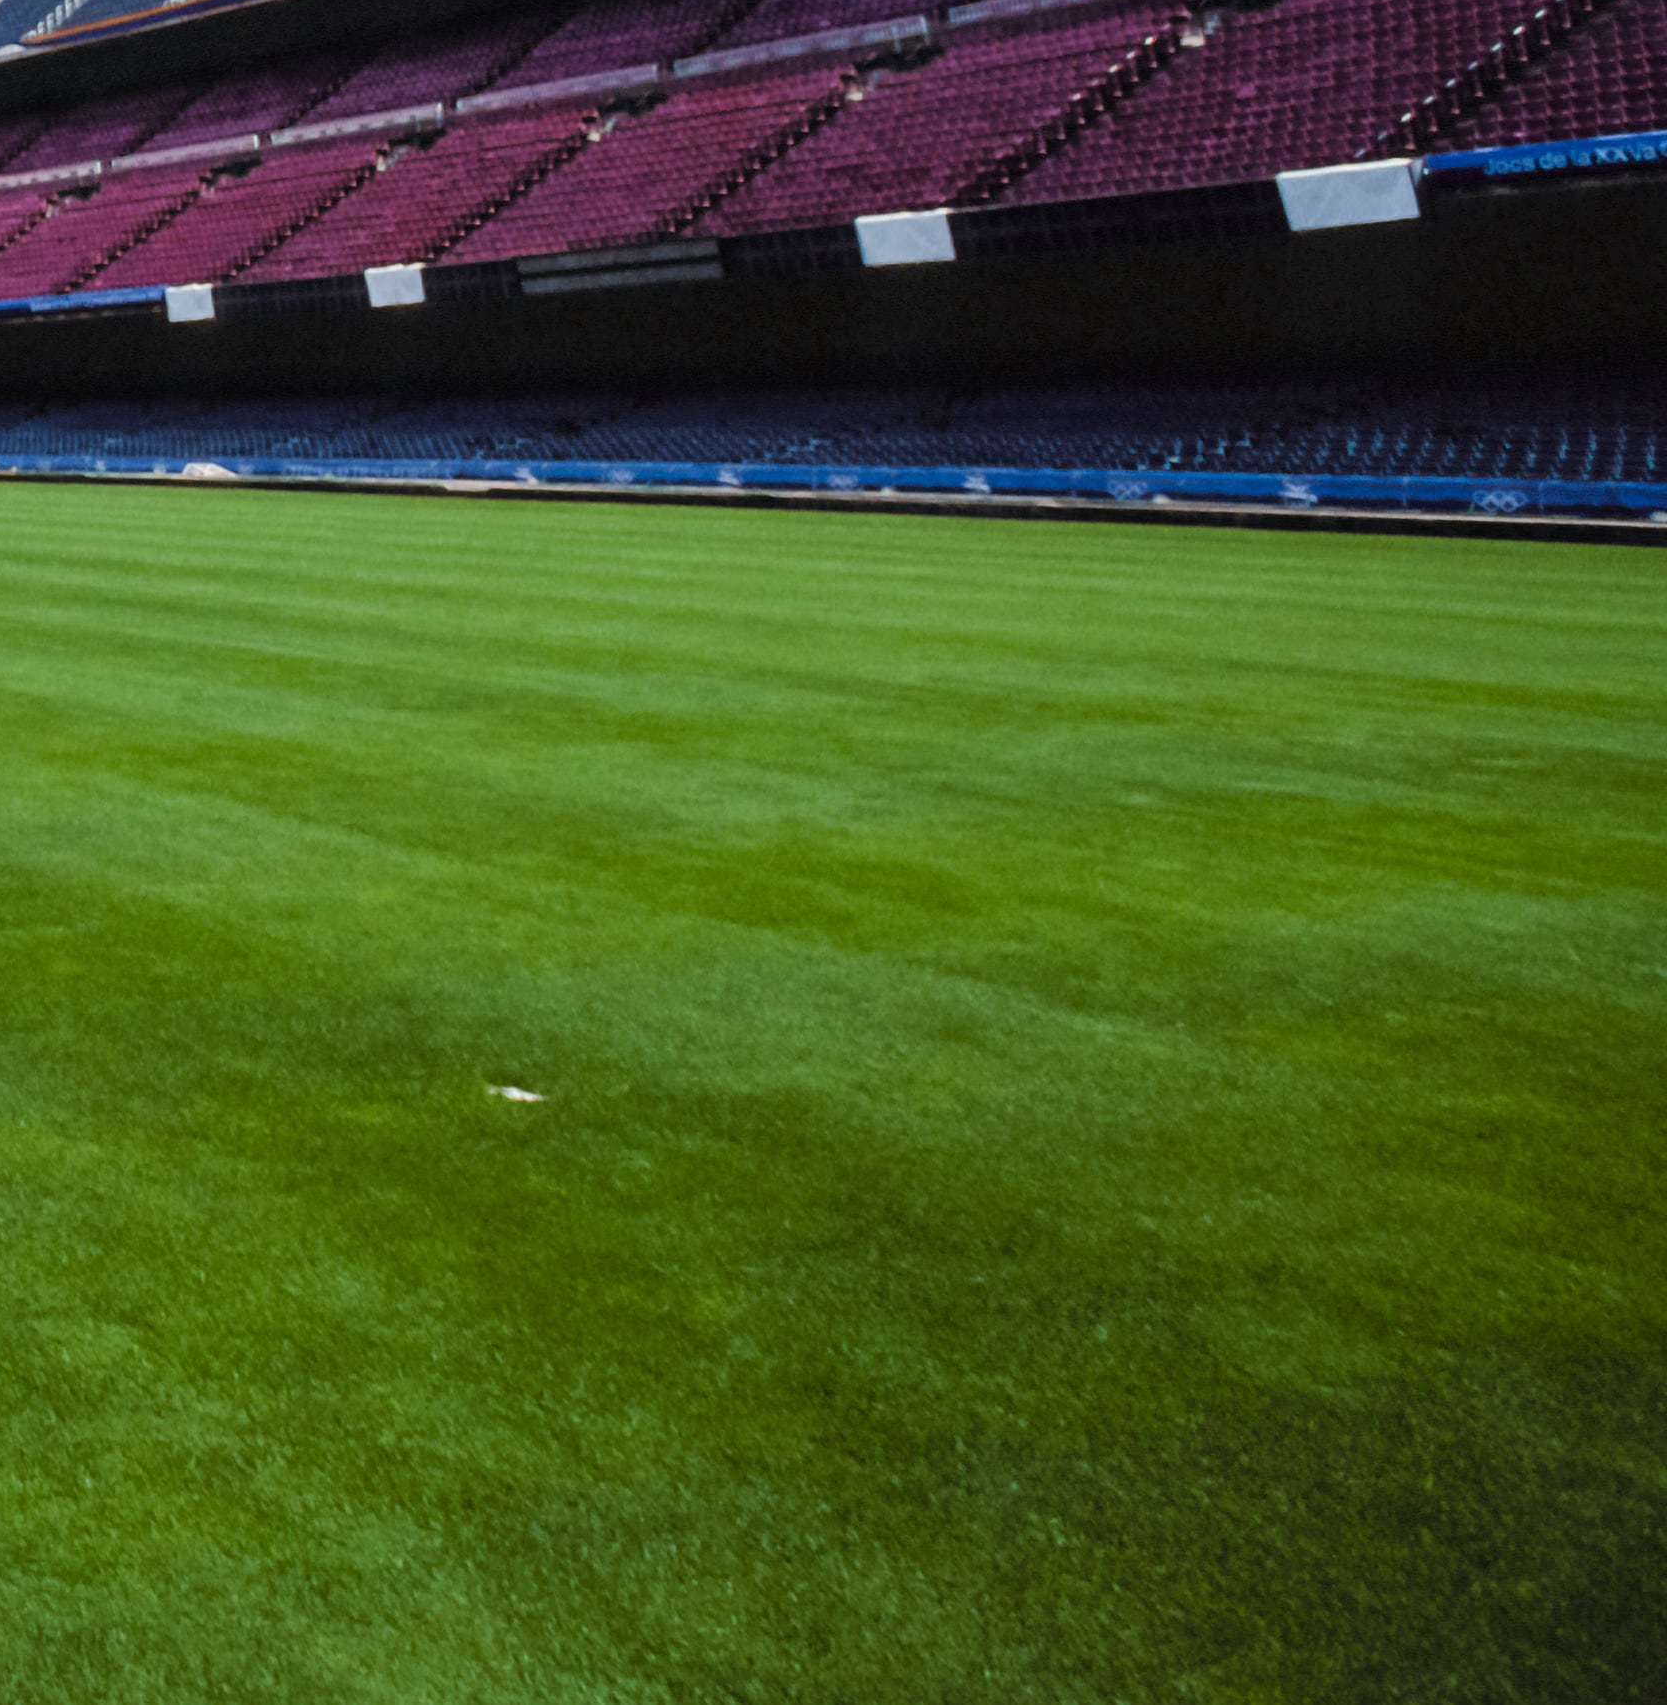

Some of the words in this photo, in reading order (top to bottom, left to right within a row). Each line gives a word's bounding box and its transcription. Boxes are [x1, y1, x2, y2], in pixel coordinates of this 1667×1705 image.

[1483, 157, 1536, 175] Jocs
[1539, 152, 1566, 170] de
[1571, 149, 1592, 166] la
